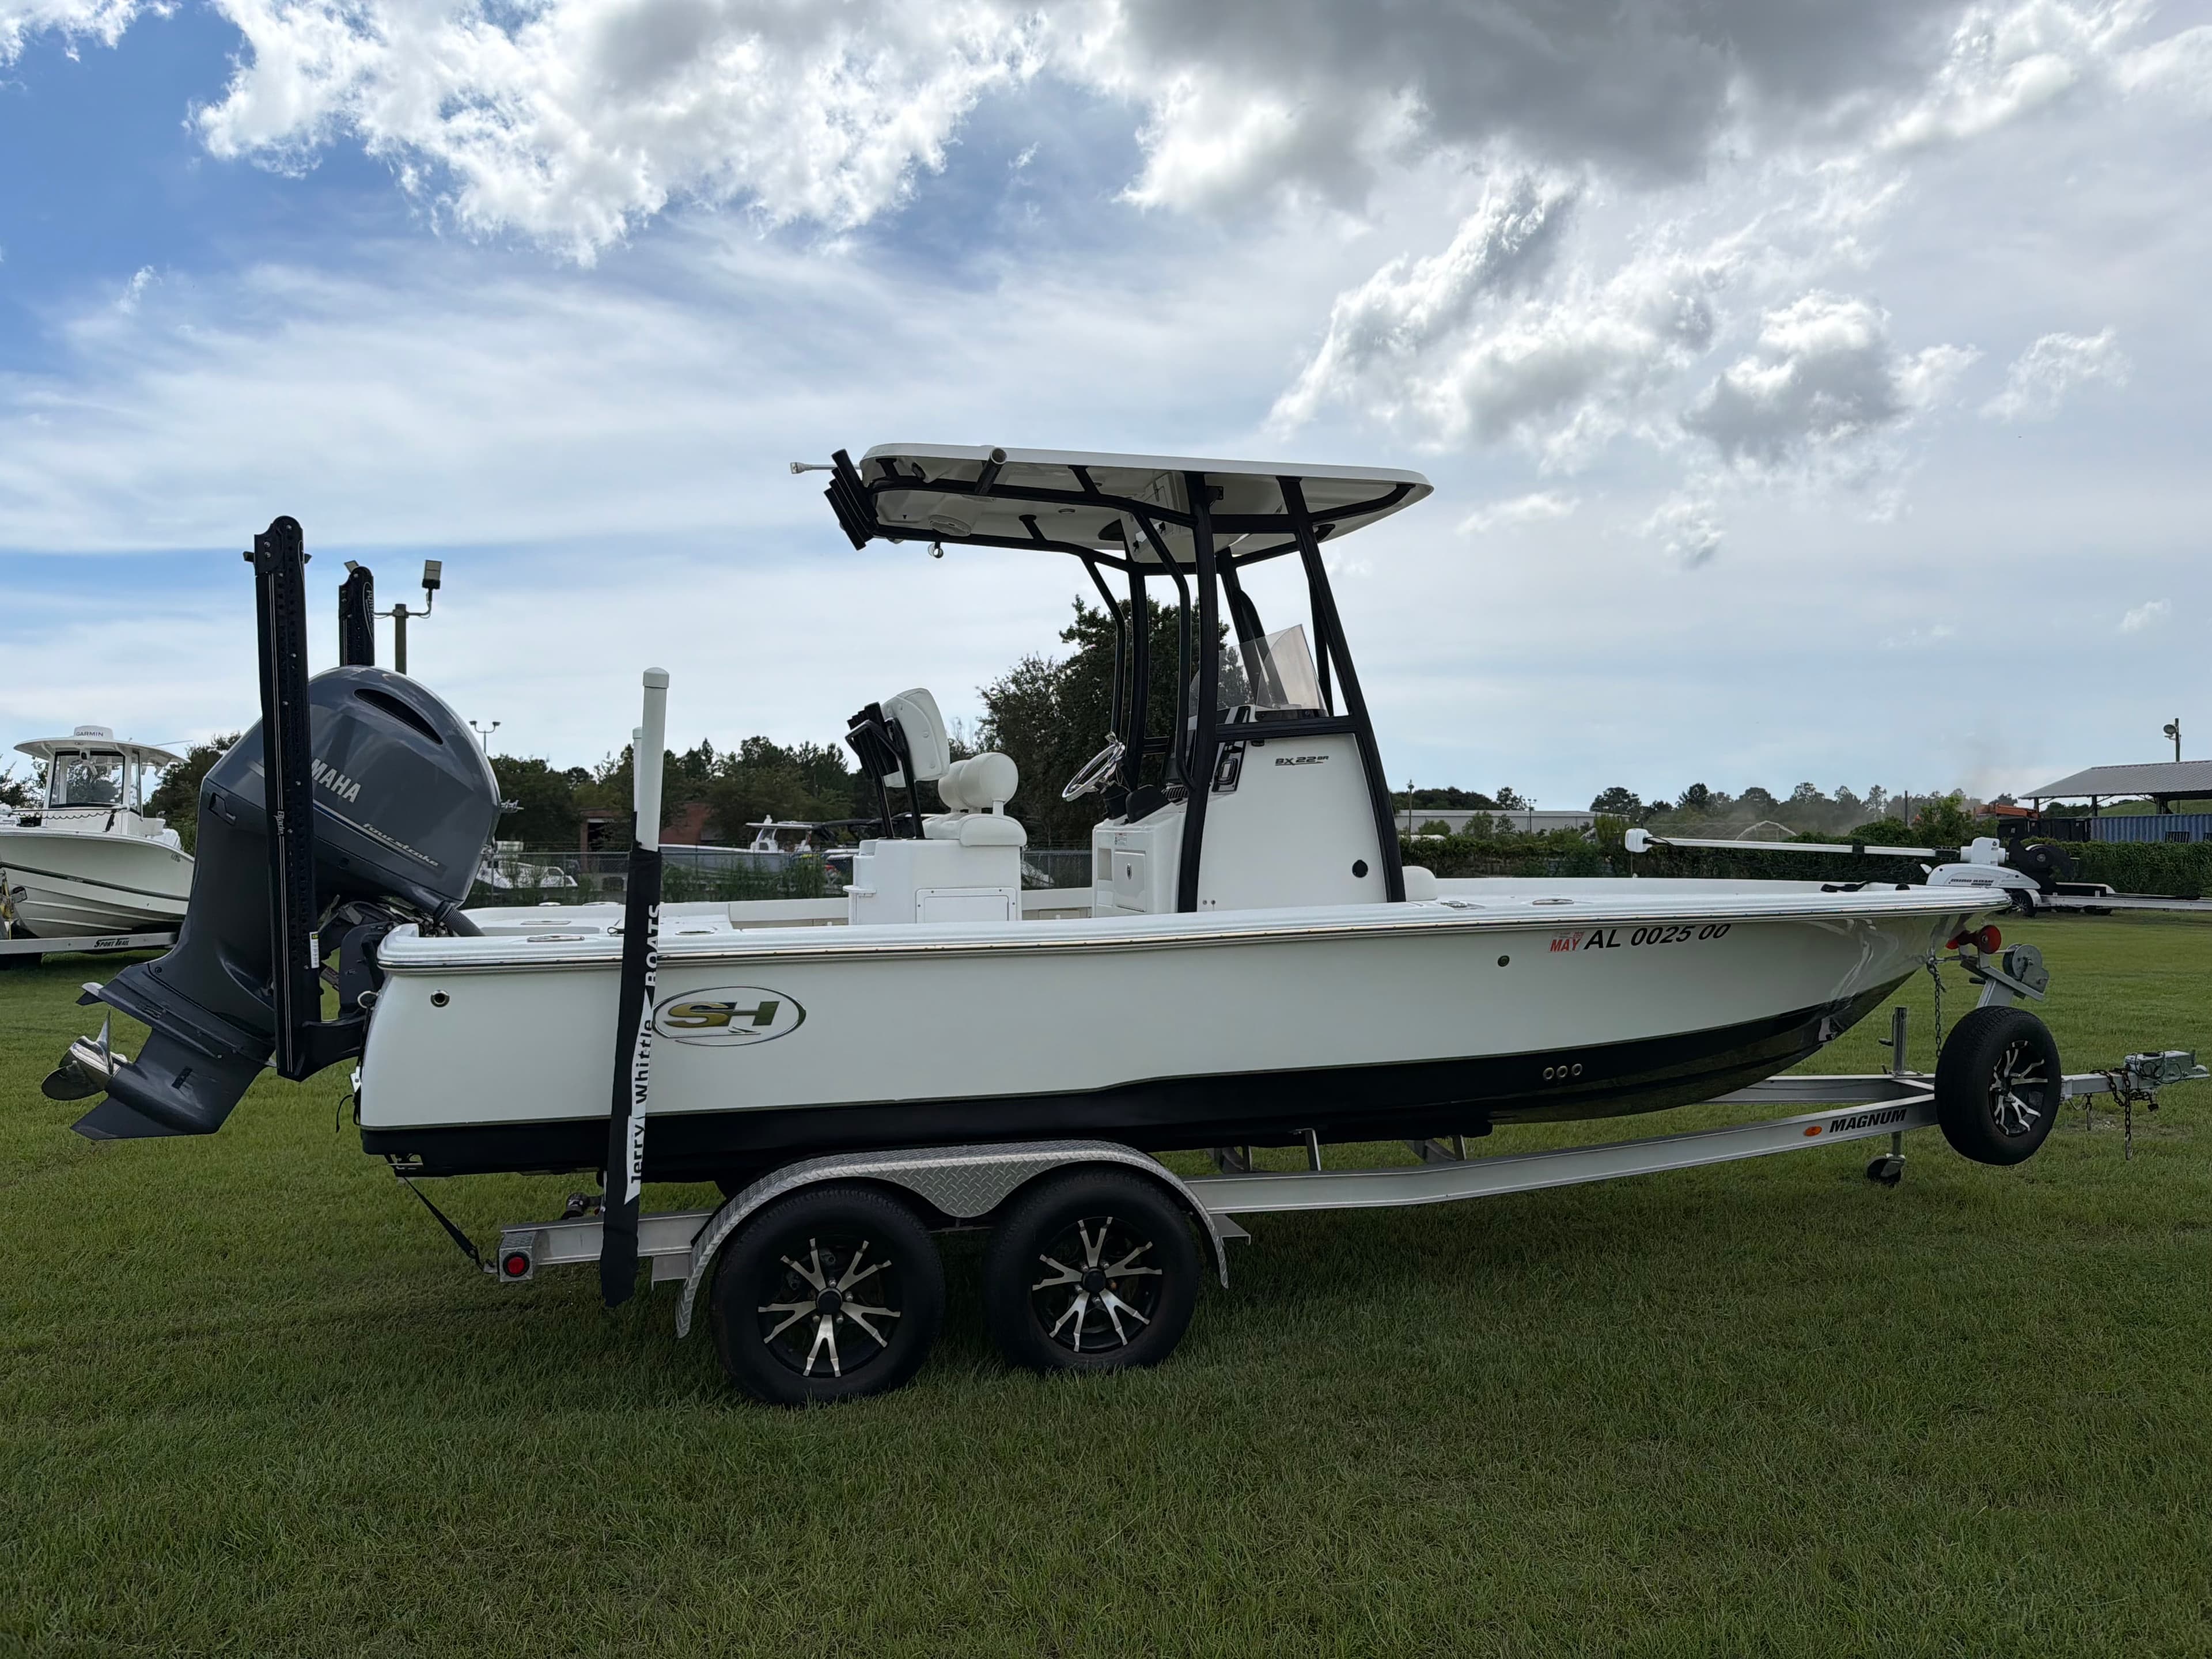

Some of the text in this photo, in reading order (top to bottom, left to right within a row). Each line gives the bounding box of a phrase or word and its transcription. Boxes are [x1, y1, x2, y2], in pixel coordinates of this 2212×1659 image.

[311, 758, 361, 803] MAHA
[1550, 938, 1581, 952] MAY
[1584, 923, 1731, 949] AL 0025 00
[664, 1001, 780, 1028] SH
[631, 904, 660, 1183] Jerry Whittle BOATS
[1829, 1109, 1907, 1133] MAGNUM
